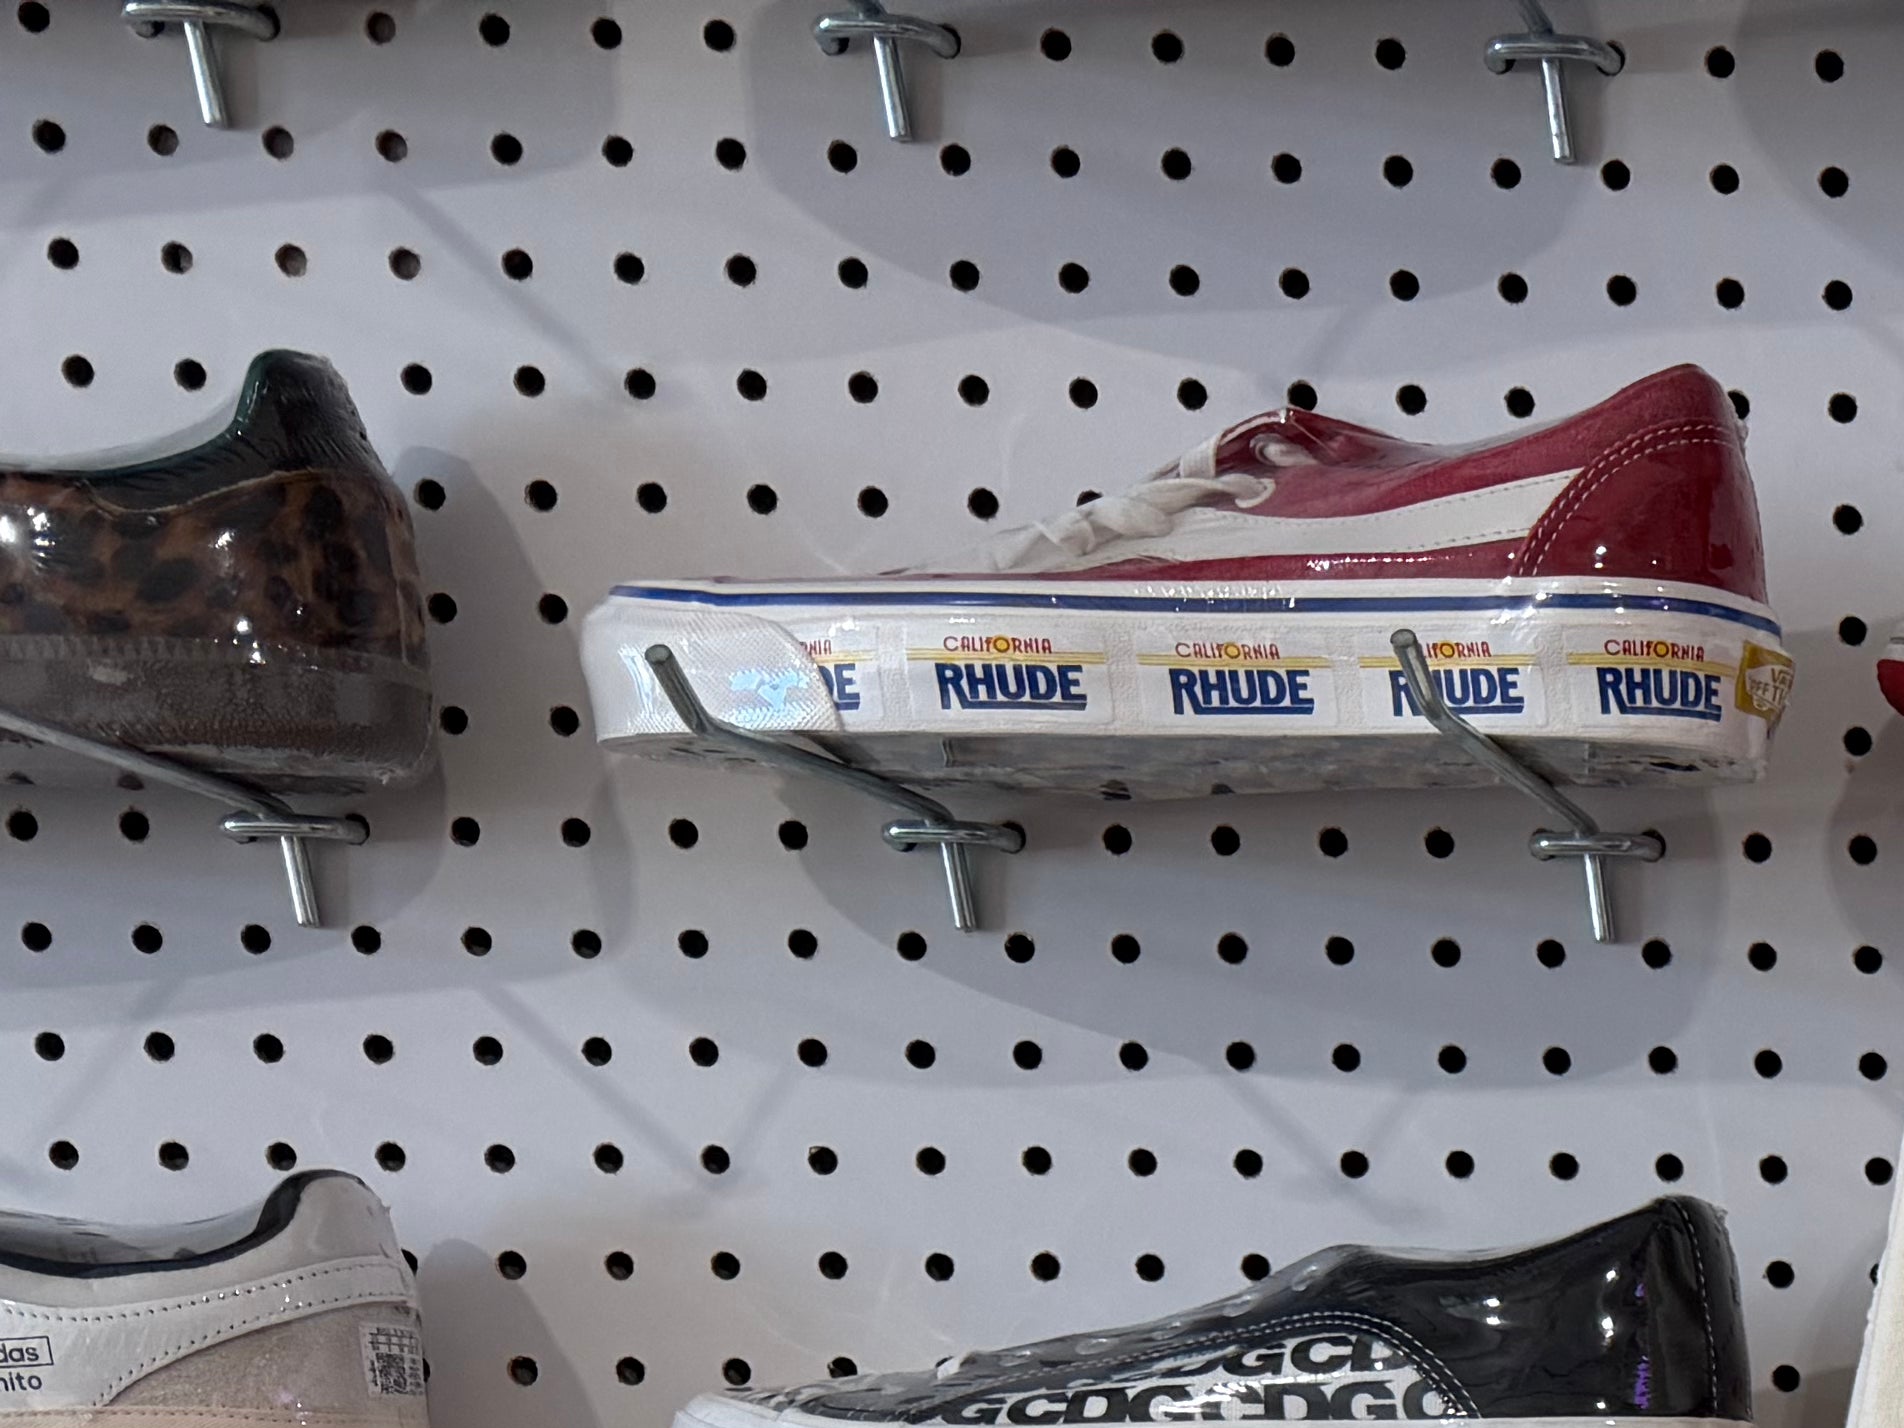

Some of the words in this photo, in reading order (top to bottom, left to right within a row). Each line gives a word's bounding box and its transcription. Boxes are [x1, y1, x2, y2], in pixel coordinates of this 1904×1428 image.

[943, 635, 1053, 656] CALIFORNIA
[1175, 641, 1281, 661] CALIFORNIA
[1604, 640, 1706, 662] CALIFORNIA
[934, 662, 1088, 711] RHUDE
[1168, 667, 1315, 716] RHUDE
[1596, 667, 1723, 722] RHUDE
